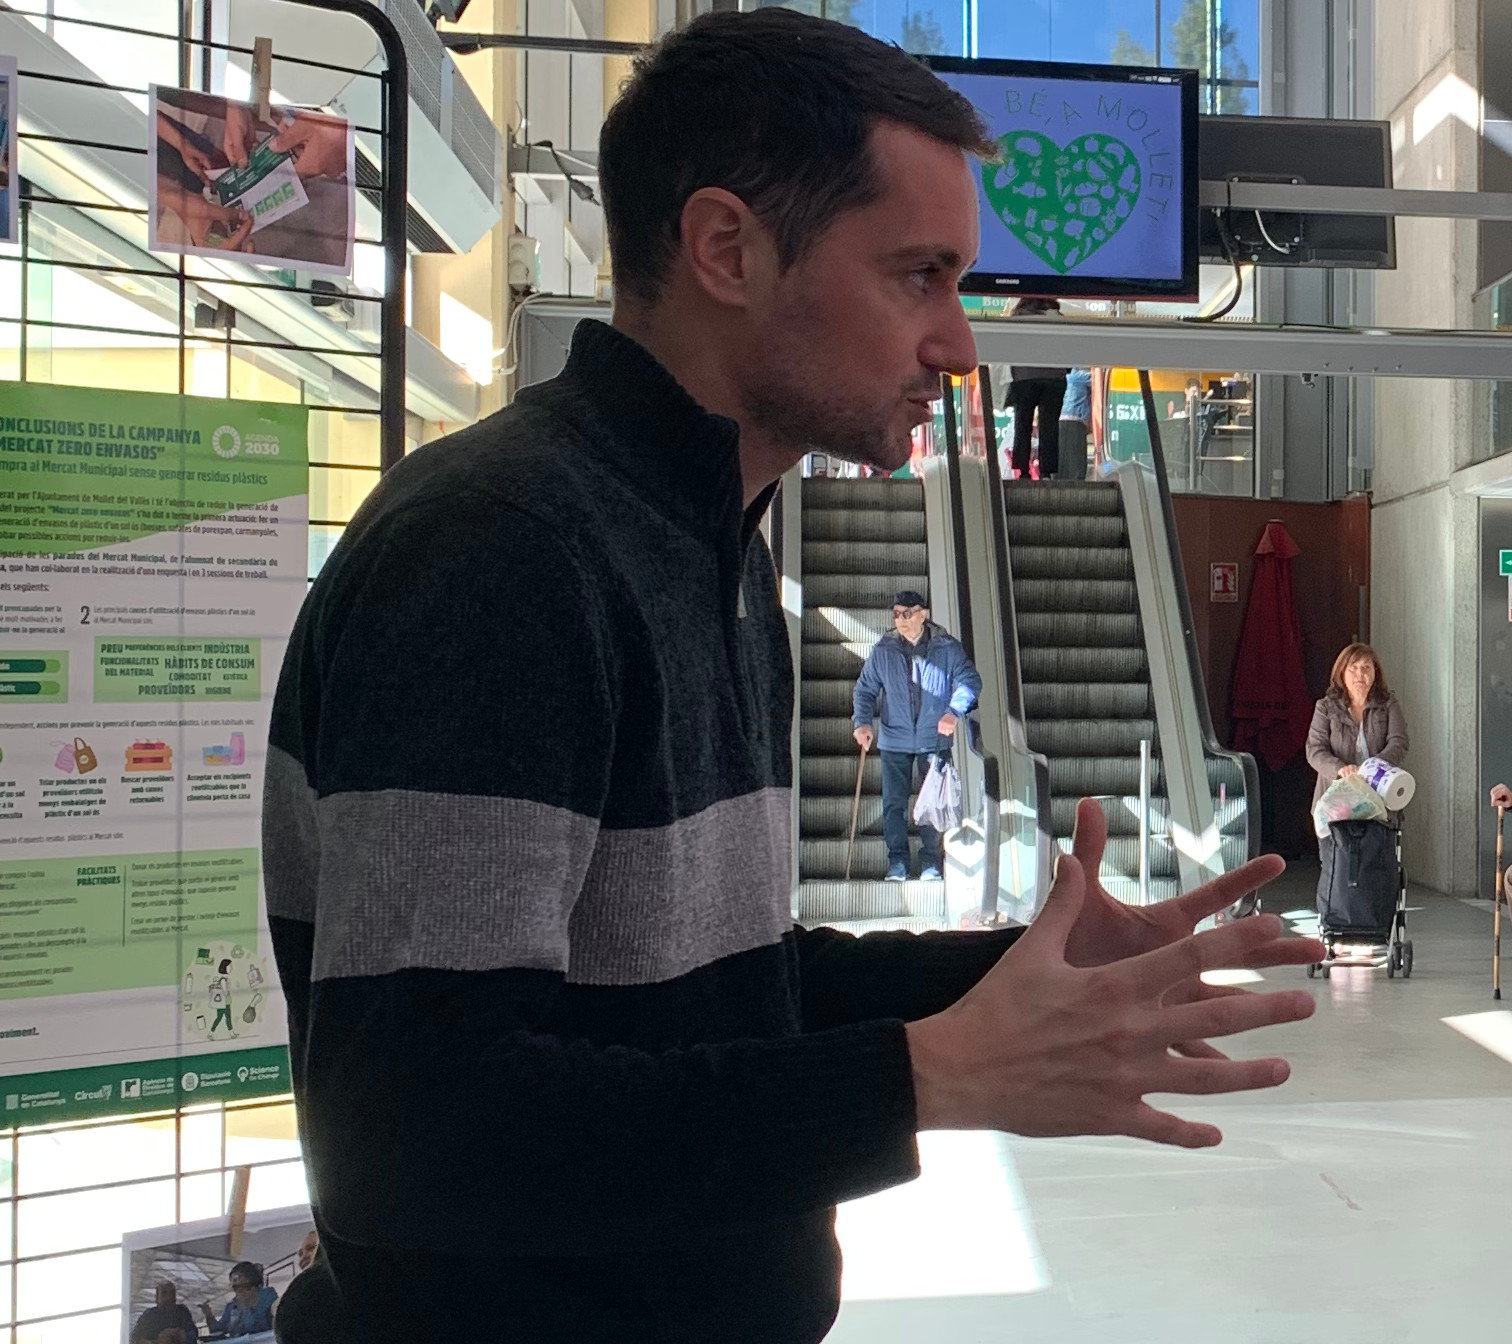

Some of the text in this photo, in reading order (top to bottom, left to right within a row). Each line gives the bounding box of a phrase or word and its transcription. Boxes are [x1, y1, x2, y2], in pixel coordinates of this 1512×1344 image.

[1063, 100, 1083, 125] A
[88, 423, 106, 438] DE
[109, 424, 125, 439] LA
[129, 425, 201, 445] CAMPANYA
[244, 434, 280, 443] AGENDA
[57, 439, 92, 456] ZERO
[245, 442, 280, 455] 2030
[30, 460, 39, 472] al
[42, 460, 77, 474] Mercat
[80, 462, 127, 477] Municipal
[129, 469, 156, 478] sense
[159, 470, 195, 481] generar
[198, 471, 230, 482] residus
[232, 472, 268, 485] plàstics
[80, 606, 90, 624] 2
[101, 644, 123, 654] PREU
[204, 643, 250, 654] INDÚSTRIA
[164, 656, 255, 669] HÀBITS DE CONSUM
[138, 683, 196, 696] PROVEÏDORS
[77, 865, 116, 875] FACILITATS
[78, 876, 120, 885] PRÀCTIQUES
